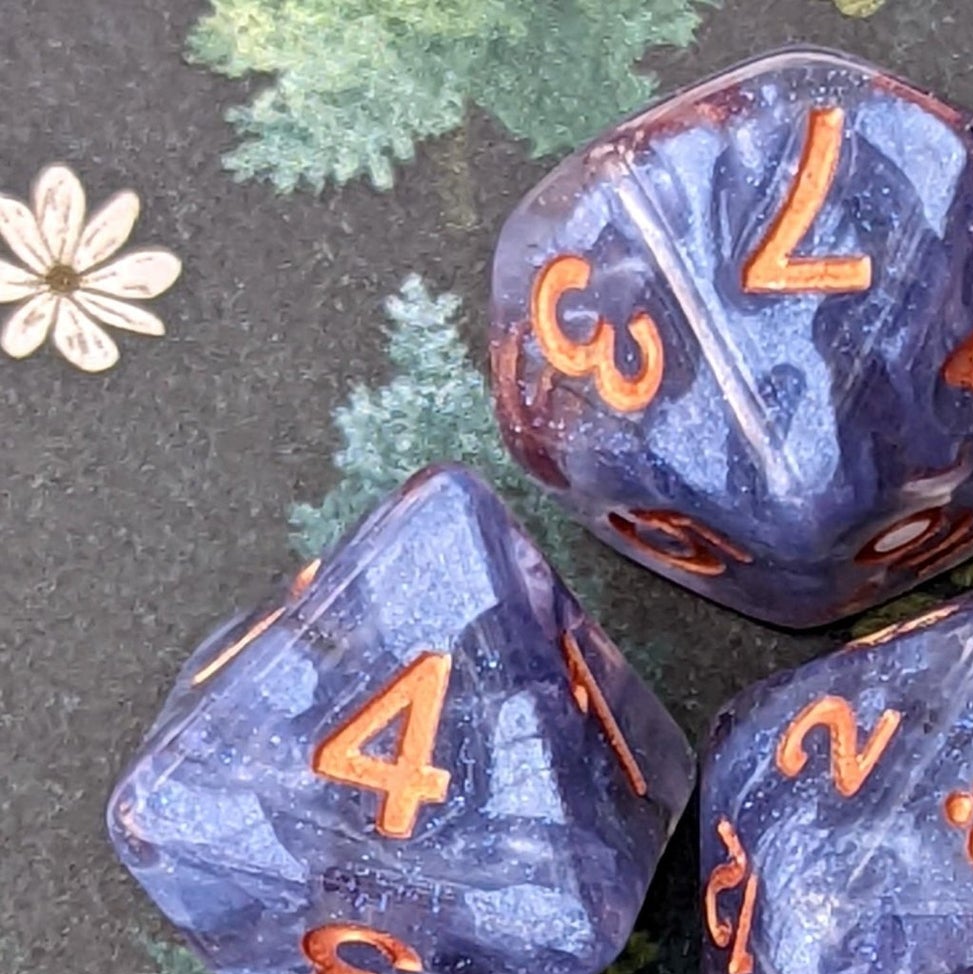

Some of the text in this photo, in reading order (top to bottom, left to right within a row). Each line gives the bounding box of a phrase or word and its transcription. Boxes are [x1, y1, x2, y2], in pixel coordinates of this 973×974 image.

[741, 106, 872, 292] 7
[530, 254, 664, 413] 3
[312, 649, 453, 840] 4
[775, 694, 902, 798] 2
